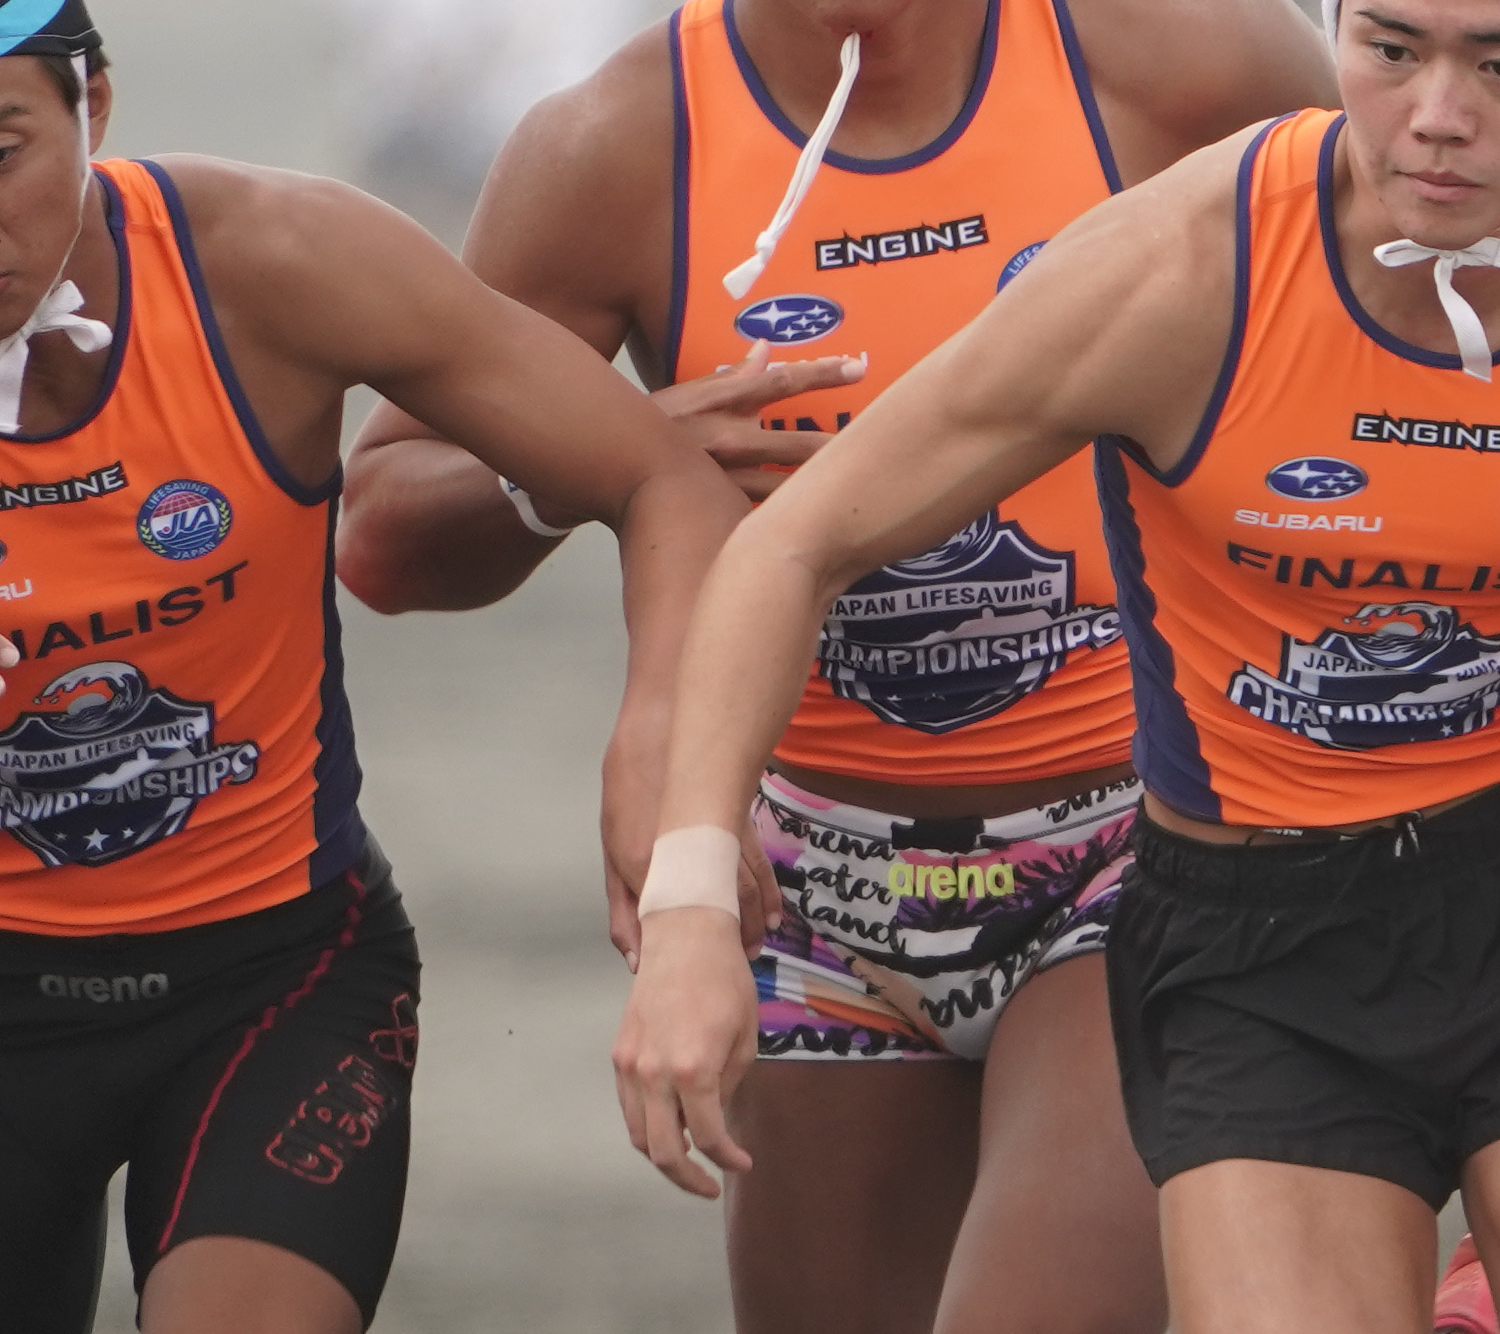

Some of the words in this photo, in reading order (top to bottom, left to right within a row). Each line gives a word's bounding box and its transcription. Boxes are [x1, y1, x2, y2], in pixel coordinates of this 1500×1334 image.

[819, 219, 984, 268] ENGINE
[0, 466, 125, 507] NGINE
[145, 481, 209, 510] LIFESAVING
[156, 505, 217, 540] JLA
[1233, 508, 1384, 533] SUBARU
[172, 541, 217, 560] JAPAN
[11, 560, 249, 661] ALIST
[906, 578, 1053, 610] LIFESAVING
[74, 721, 196, 762] LIFESAVING
[888, 862, 1016, 900] arena
[38, 970, 170, 1003] arena
